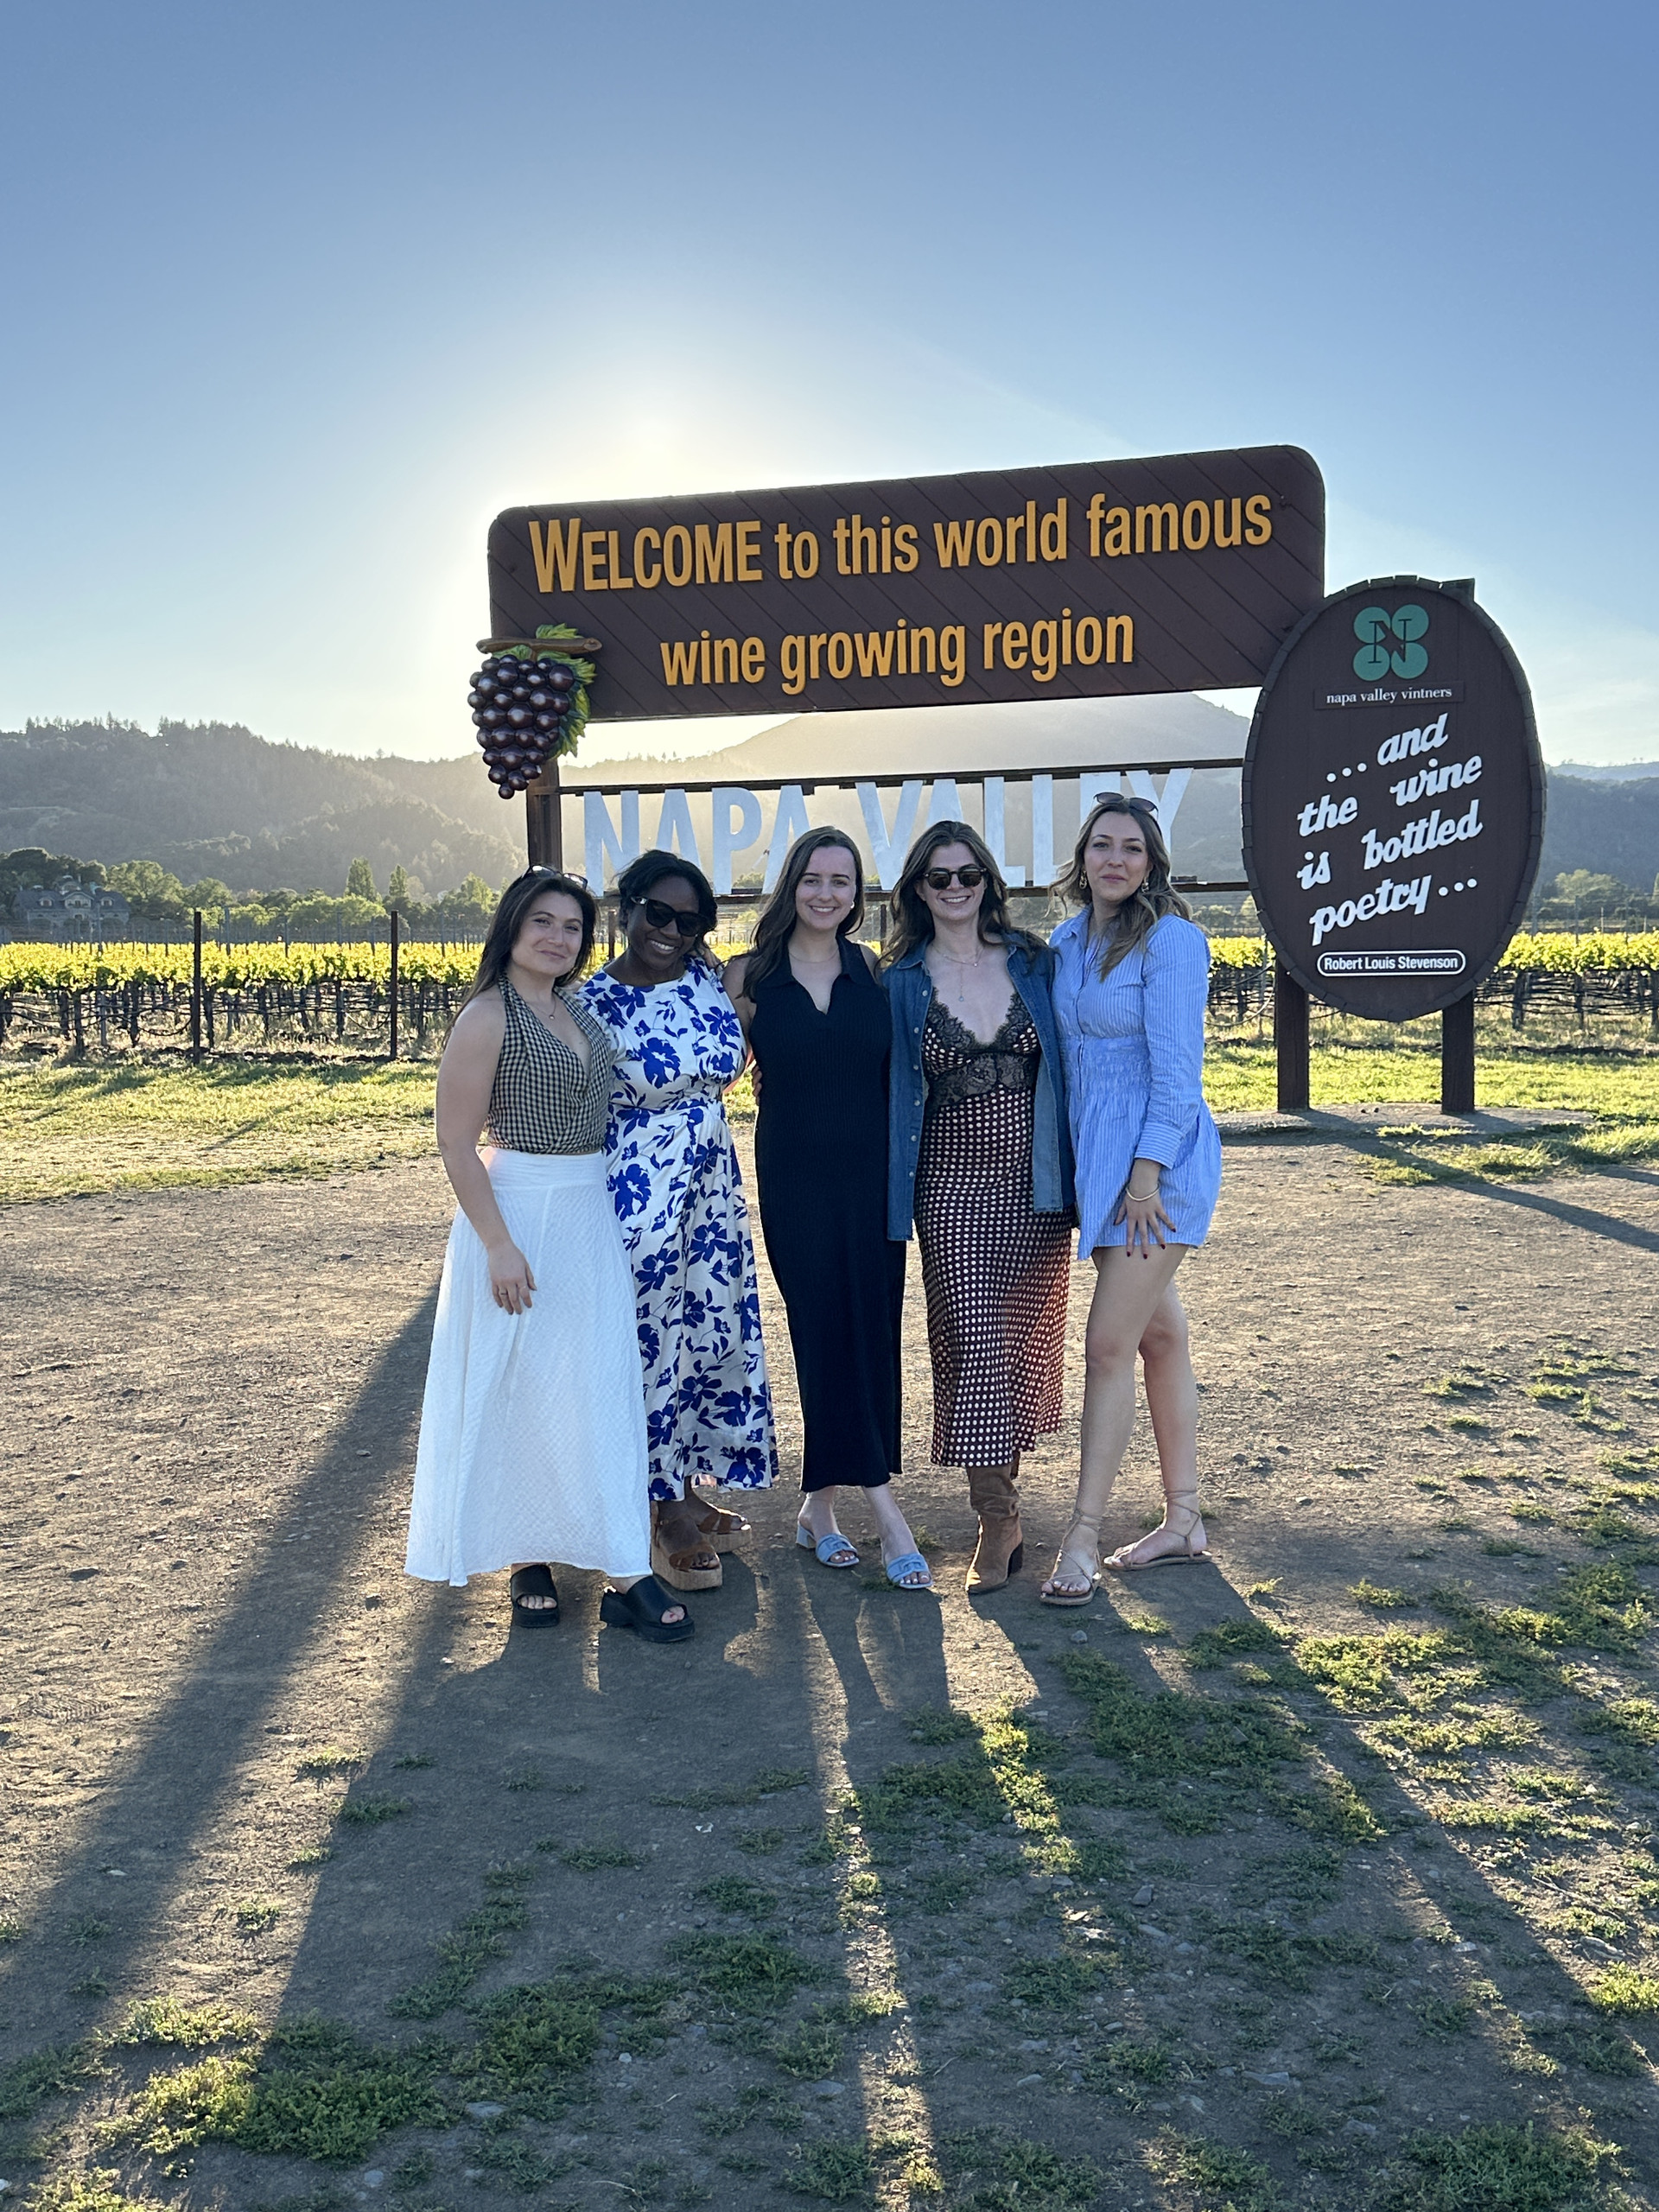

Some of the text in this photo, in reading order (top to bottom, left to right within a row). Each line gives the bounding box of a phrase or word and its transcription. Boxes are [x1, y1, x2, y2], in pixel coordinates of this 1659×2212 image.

[529, 493, 1272, 593] WELCOME to this world famous
[660, 607, 1134, 695] wine growing region
[1326, 687, 1452, 706] napa valley vintners
[1296, 755, 1482, 837] the wine
[1296, 798, 1484, 890] is bottled
[1324, 955, 1459, 970] Robert Louis Stevenson
